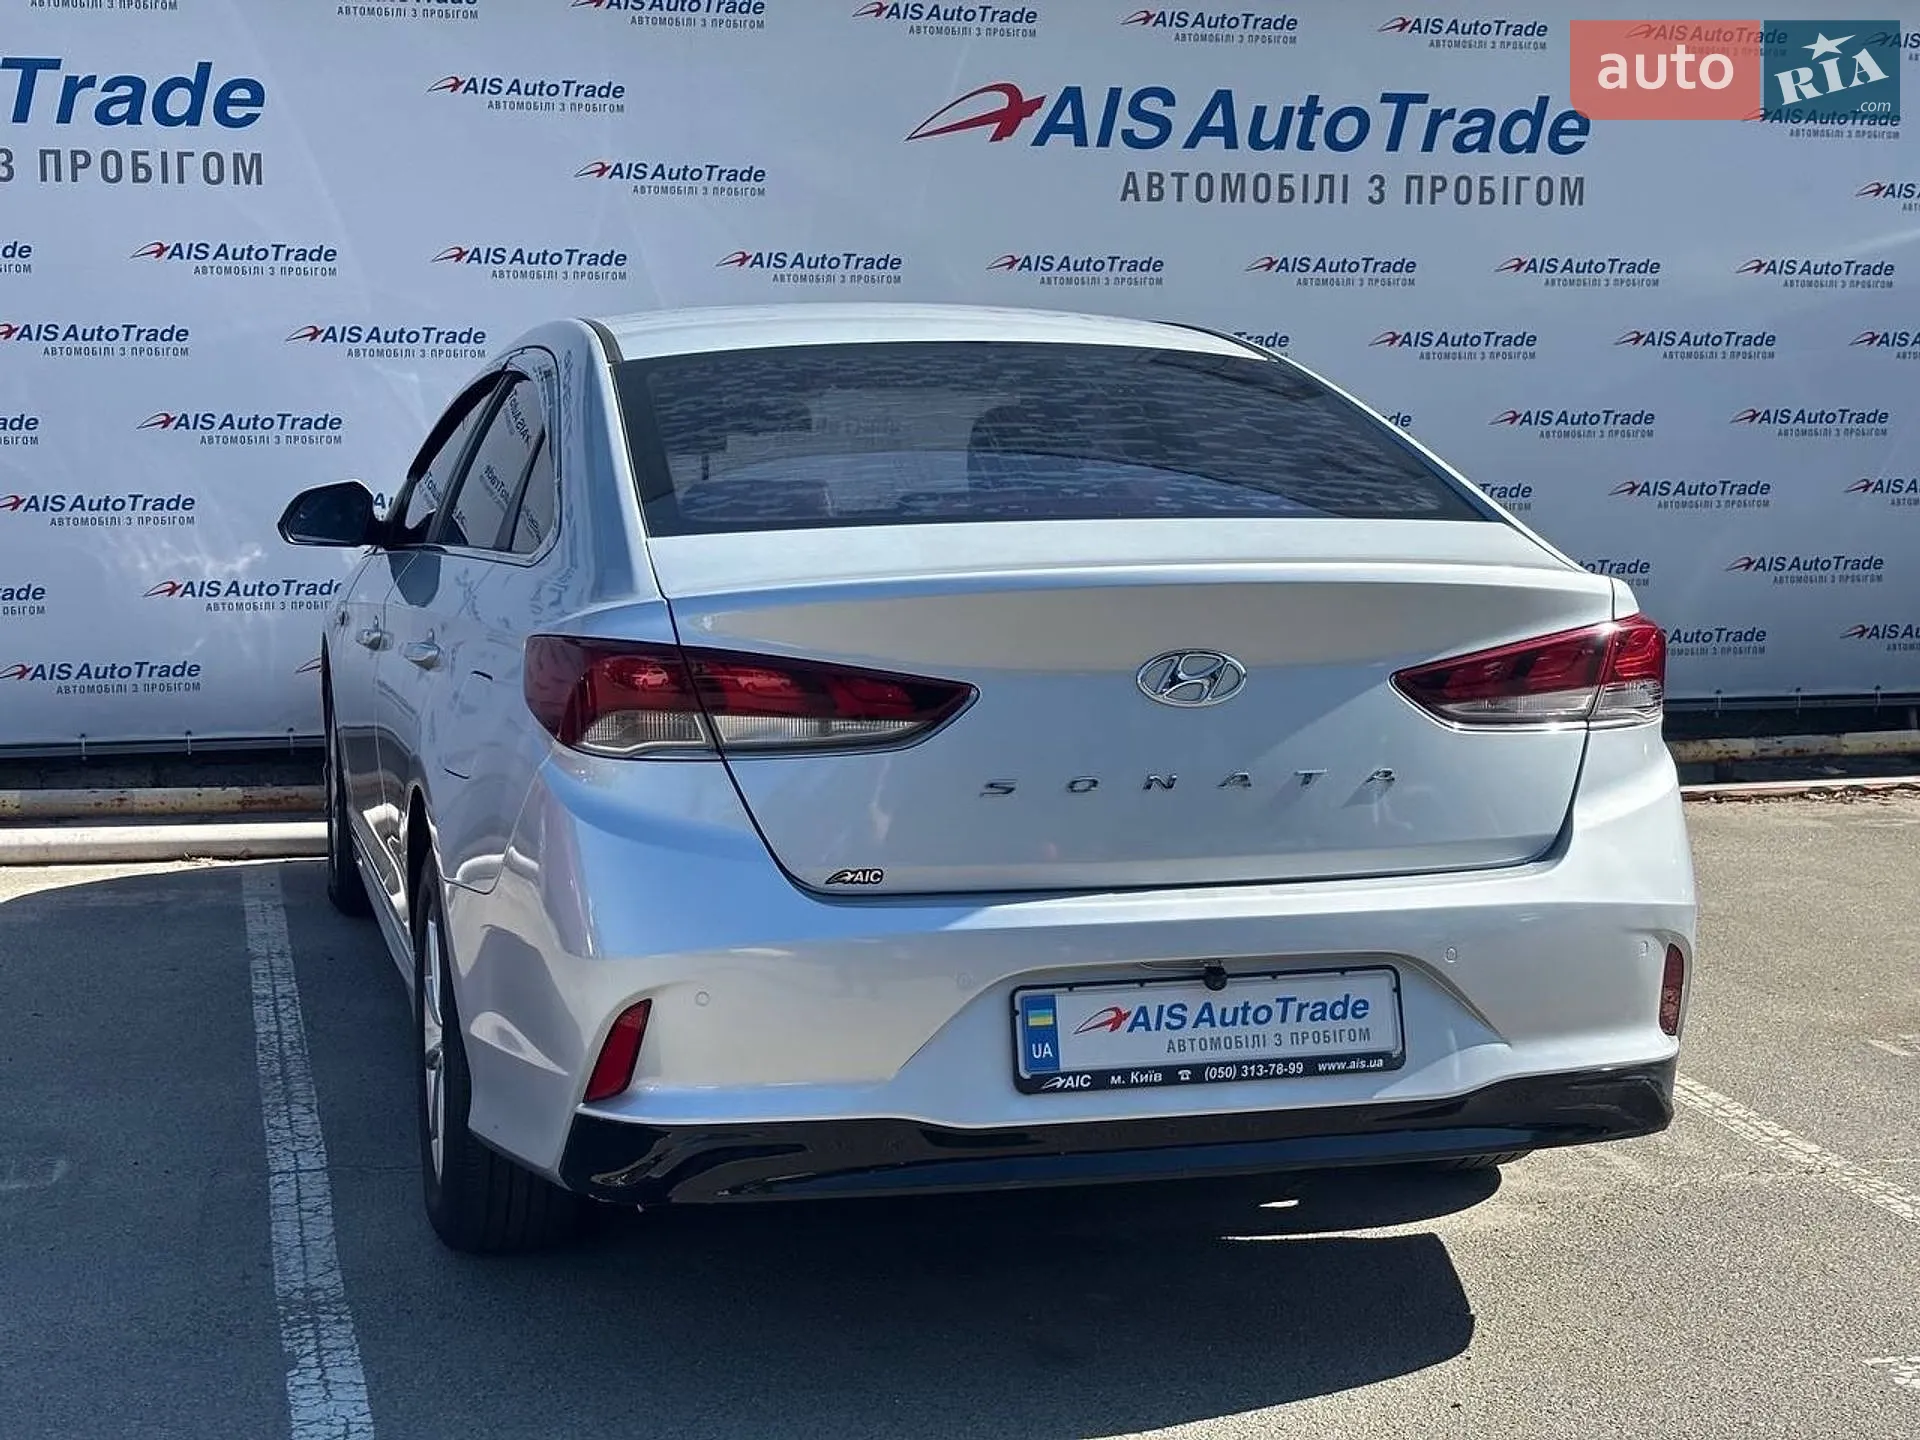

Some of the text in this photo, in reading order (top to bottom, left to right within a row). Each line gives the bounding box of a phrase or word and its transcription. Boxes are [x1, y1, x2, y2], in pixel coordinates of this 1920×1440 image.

[337, 6, 404, 17] АВТОМОБІЛІ
[422, 9, 479, 19] ПРОБІГОМ
[607, 0, 647, 11] AIS
[885, 2, 1037, 23] AIS AutoTrade
[631, 16, 696, 27] АВТОМОБІЛІ
[711, 18, 765, 29] ПРОБІГОМ
[1152, 11, 1298, 31] AIS AutoTrade
[1408, 18, 1548, 37] AIS AutoTrade
[908, 25, 972, 36] АВТОМОБІЛІ
[985, 28, 1037, 38] ПРОБІГОМ
[1174, 32, 1235, 43] АВТОМОБІЛІ
[1248, 35, 1297, 45] ПРОБІГОМ
[1654, 25, 1688, 43] AIS
[1428, 39, 1488, 49] АВТОМОБІЛІ
[1500, 41, 1547, 51] ПРОБІГОМ
[461, 77, 626, 99] AIS AutoTrade
[487, 100, 555, 112] АВТОМОБІЛІ
[570, 103, 625, 113] ПРОБІГОМ
[1030, 86, 1591, 156] AIS AutoTrade
[1771, 108, 1801, 125] AIS
[39, 149, 263, 186] ПРОБІГОМ
[608, 163, 766, 182] AIS AutoTrade
[632, 185, 698, 196] АВТОМОБІЛІ
[712, 187, 766, 197] ПРОБІГОМ
[1120, 171, 1585, 207] АВТОМОБІЛІ З ПРОБІГОМ
[1884, 183, 1913, 198] AIS
[167, 243, 337, 262] AIS AutoTrade
[466, 247, 627, 266] AIS AutoTrade
[749, 252, 903, 270] AIS AutoTrade
[1017, 255, 1164, 272] AIS AutoTrade
[1275, 257, 1417, 273] AIS AutoTrade
[1523, 258, 1660, 274] AIS AutoTrade
[1763, 260, 1895, 276] AIS AutoTrade
[193, 266, 264, 276] АВТОМОБІЛІ
[280, 266, 337, 277] ПРОБІГОМ
[491, 270, 558, 281] АВТОМОБІЛІ
[572, 271, 627, 281] ПРОБІГОМ
[772, 274, 836, 284] АВТОМОБІЛІ
[849, 275, 902, 285] ПРОБІГОМ
[1039, 276, 1101, 286] АВТОМОБІЛІ
[1113, 277, 1164, 287] ПРОБІГОМ
[1296, 277, 1355, 287] АВТОМОБІЛІ
[1367, 278, 1416, 287] ПРОБІГОМ
[16, 324, 189, 342] AIS AutoTrade
[320, 326, 487, 344] AIS AutoTrade
[1402, 331, 1537, 347] AIS AutoTrade
[1642, 331, 1776, 347] AIS AutoTrade
[1877, 332, 1909, 346] AIS
[43, 347, 115, 357] АВТОМОБІЛІ
[131, 346, 189, 357] ПРОБІГОМ
[346, 348, 416, 359] АВТОМОБІЛІ
[431, 348, 486, 359] ПРОБІГОМ
[176, 413, 343, 430] AIS AutoTrade
[1520, 410, 1655, 426] AIS AutoTrade
[1759, 409, 1889, 424] AIS AutoTrade
[199, 435, 270, 446] АВТОМОБІЛІ
[285, 434, 342, 446] ПРОБІГОМ
[1637, 480, 1770, 496] AIS AutoTrade
[1872, 479, 1903, 493] AIS
[23, 494, 195, 512] AIS AutoTrade
[49, 516, 122, 527] АВТОМОБІЛІ
[136, 515, 195, 527] ПРОБІГОМ
[1752, 556, 1884, 572] AIS AutoTrade
[180, 581, 222, 598] AIS
[290, 601, 332, 611] ПРОБІГ
[1668, 627, 1766, 644] AutoTrade
[1867, 624, 1899, 639] AIS
[31, 661, 202, 680] AIS AutoTrade
[56, 684, 127, 695] АВТОМОБІЛІ
[143, 682, 201, 693] ПРОБІГОМ
[979, 767, 1397, 798] SONATA
[1127, 993, 1370, 1032] AIS AutoTrade
[1167, 1028, 1371, 1053] АВТОМОБІЛІ З ПРОБІГОМ
[1031, 1043, 1053, 1059] UA
[1204, 1062, 1304, 1082] (050) 313-78-99
[1317, 1057, 1384, 1073] www.ais.ua
[1110, 1071, 1163, 1085] м. Київ
